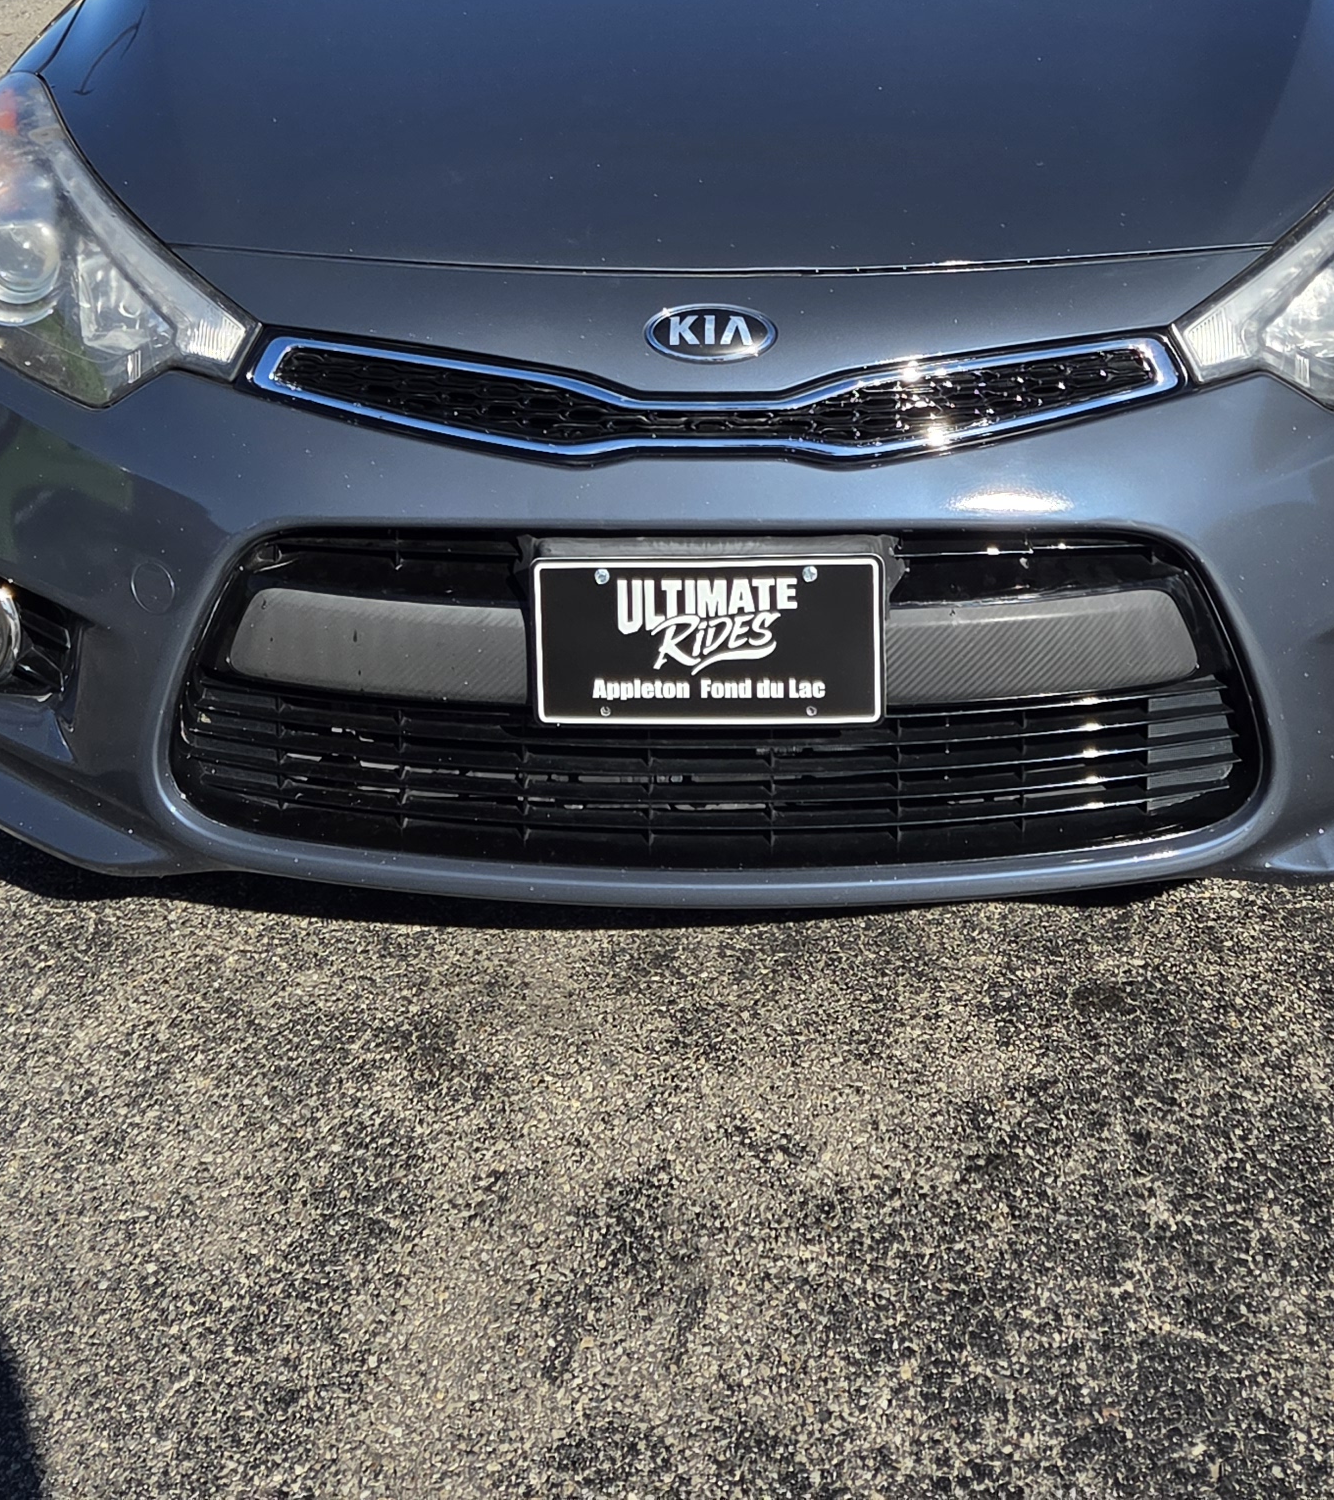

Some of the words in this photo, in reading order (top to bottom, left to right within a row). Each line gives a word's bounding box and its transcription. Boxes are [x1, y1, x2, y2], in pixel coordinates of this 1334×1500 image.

[669, 315, 754, 345] KIA
[616, 577, 798, 635] ULTIMATE
[592, 677, 690, 701] Appleton
[700, 678, 752, 699] Fond
[756, 678, 784, 699] du
[788, 678, 826, 699] Lac
